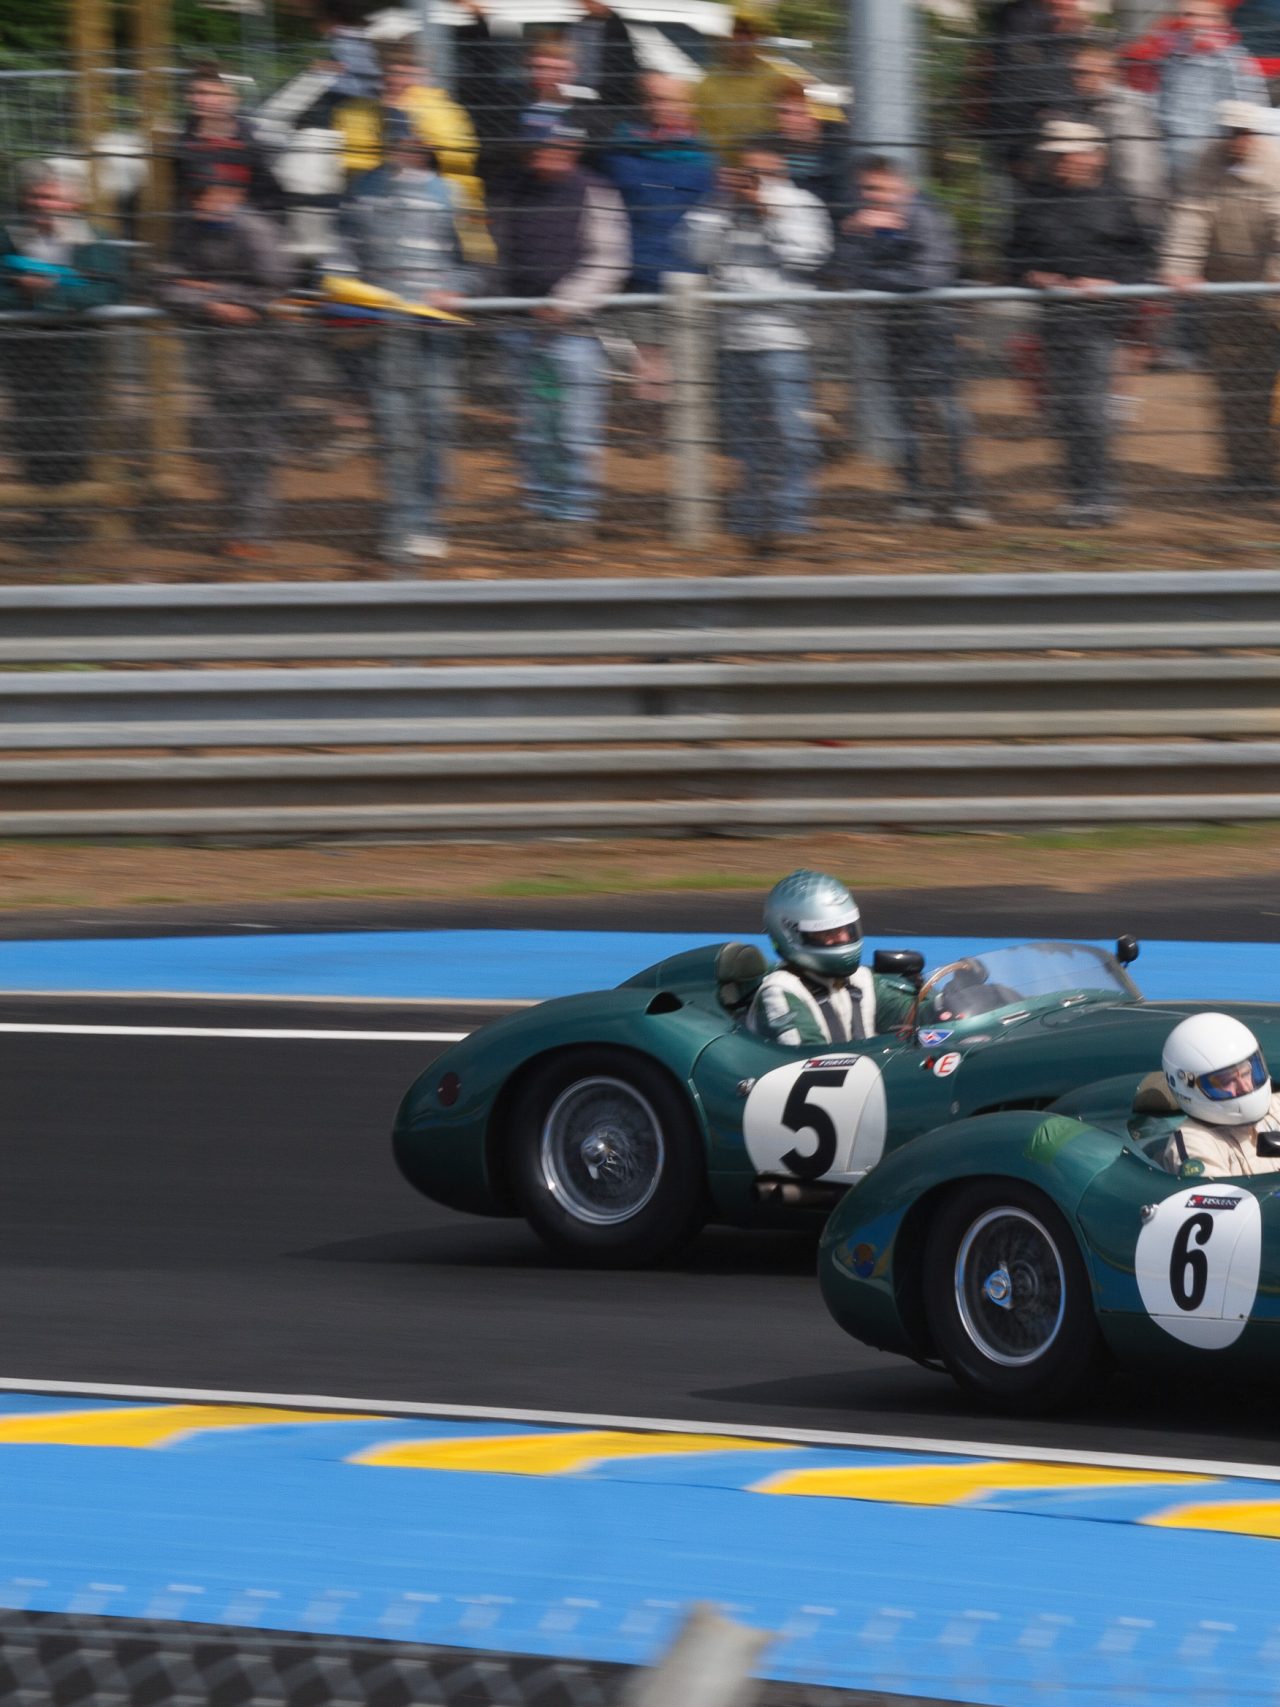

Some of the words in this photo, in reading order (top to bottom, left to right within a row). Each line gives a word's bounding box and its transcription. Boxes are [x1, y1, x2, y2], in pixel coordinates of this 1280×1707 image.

[938, 1055, 956, 1073] E
[780, 1069, 849, 1179] 5
[1169, 1212, 1214, 1312] 6
